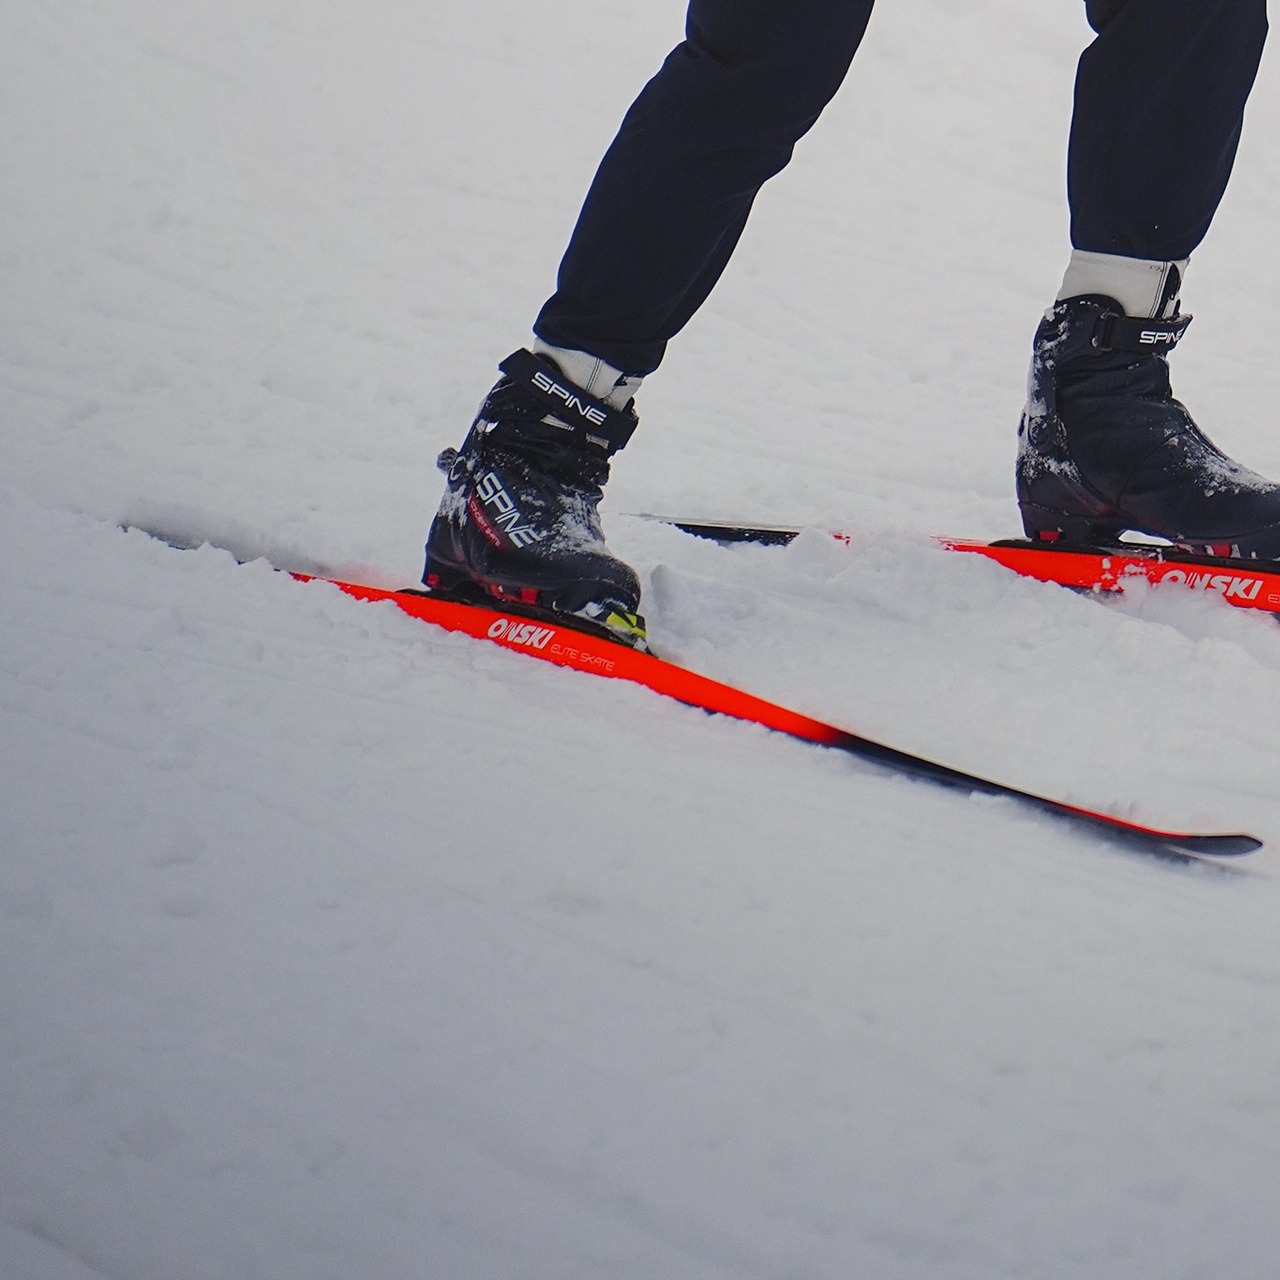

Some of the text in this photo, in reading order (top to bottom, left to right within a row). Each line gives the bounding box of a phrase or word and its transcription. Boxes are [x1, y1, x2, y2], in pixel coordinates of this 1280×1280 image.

[531, 371, 607, 426] SPINE
[476, 471, 544, 549] SPINE
[487, 618, 615, 671] ONSKI ELITE SKATE
